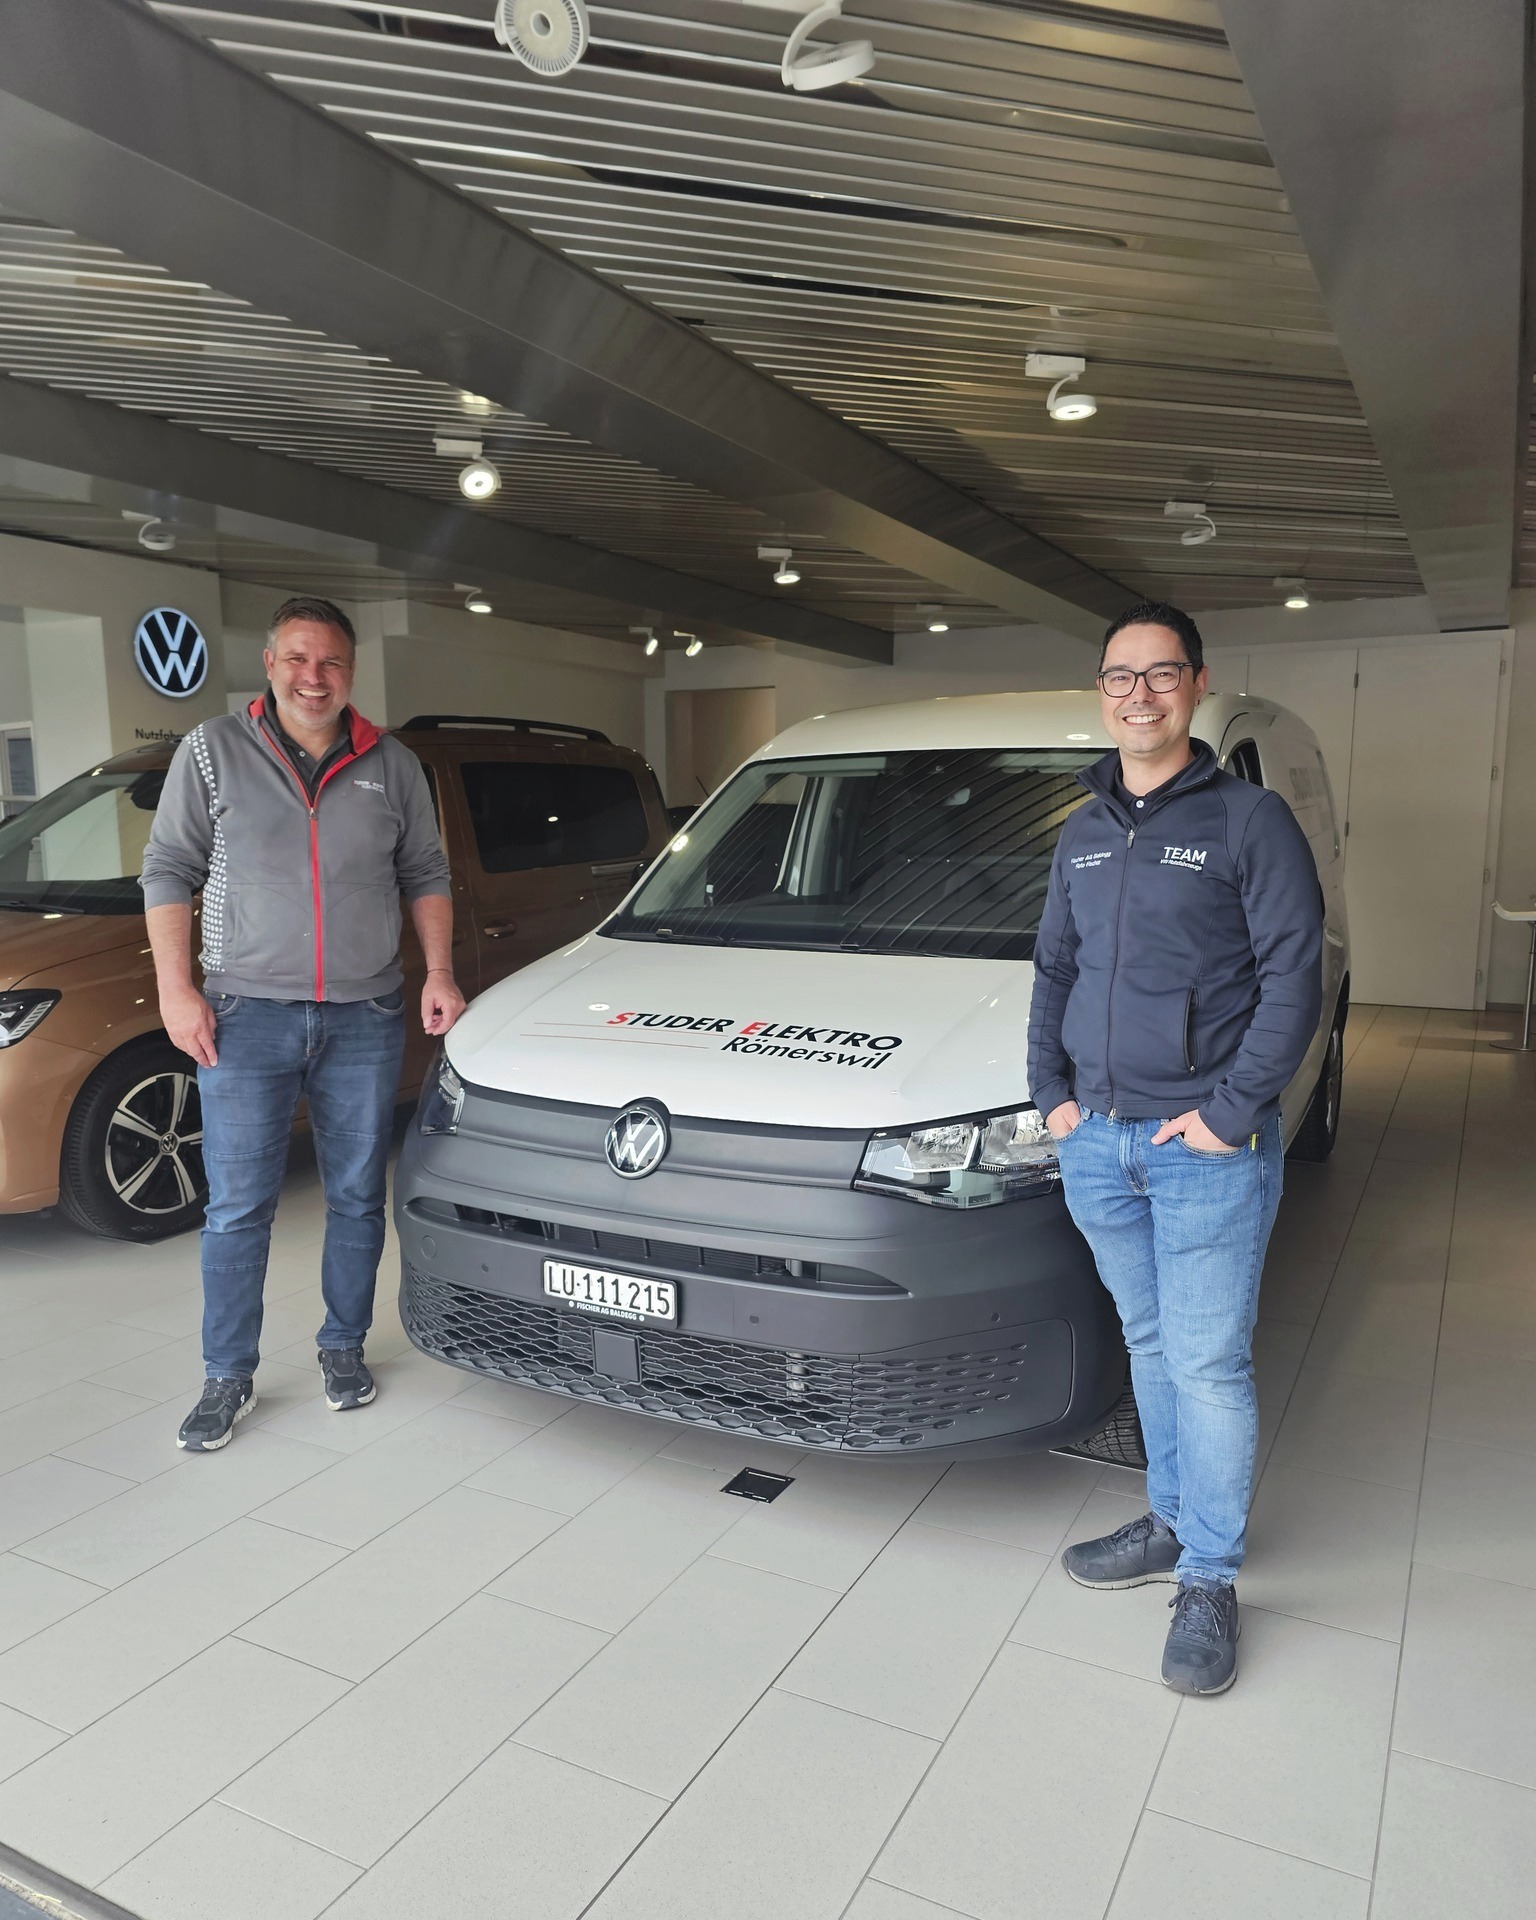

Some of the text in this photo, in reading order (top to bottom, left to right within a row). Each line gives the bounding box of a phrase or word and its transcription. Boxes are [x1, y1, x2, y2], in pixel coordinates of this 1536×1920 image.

[135, 608, 208, 697] VW
[1164, 846, 1207, 864] TEAM
[606, 1012, 903, 1051] STUDER ELEKTRO
[720, 1036, 892, 1070] Römerswil
[605, 1106, 666, 1179] VW
[576, 1302, 637, 1320] FISCHER AG BALDEGG
